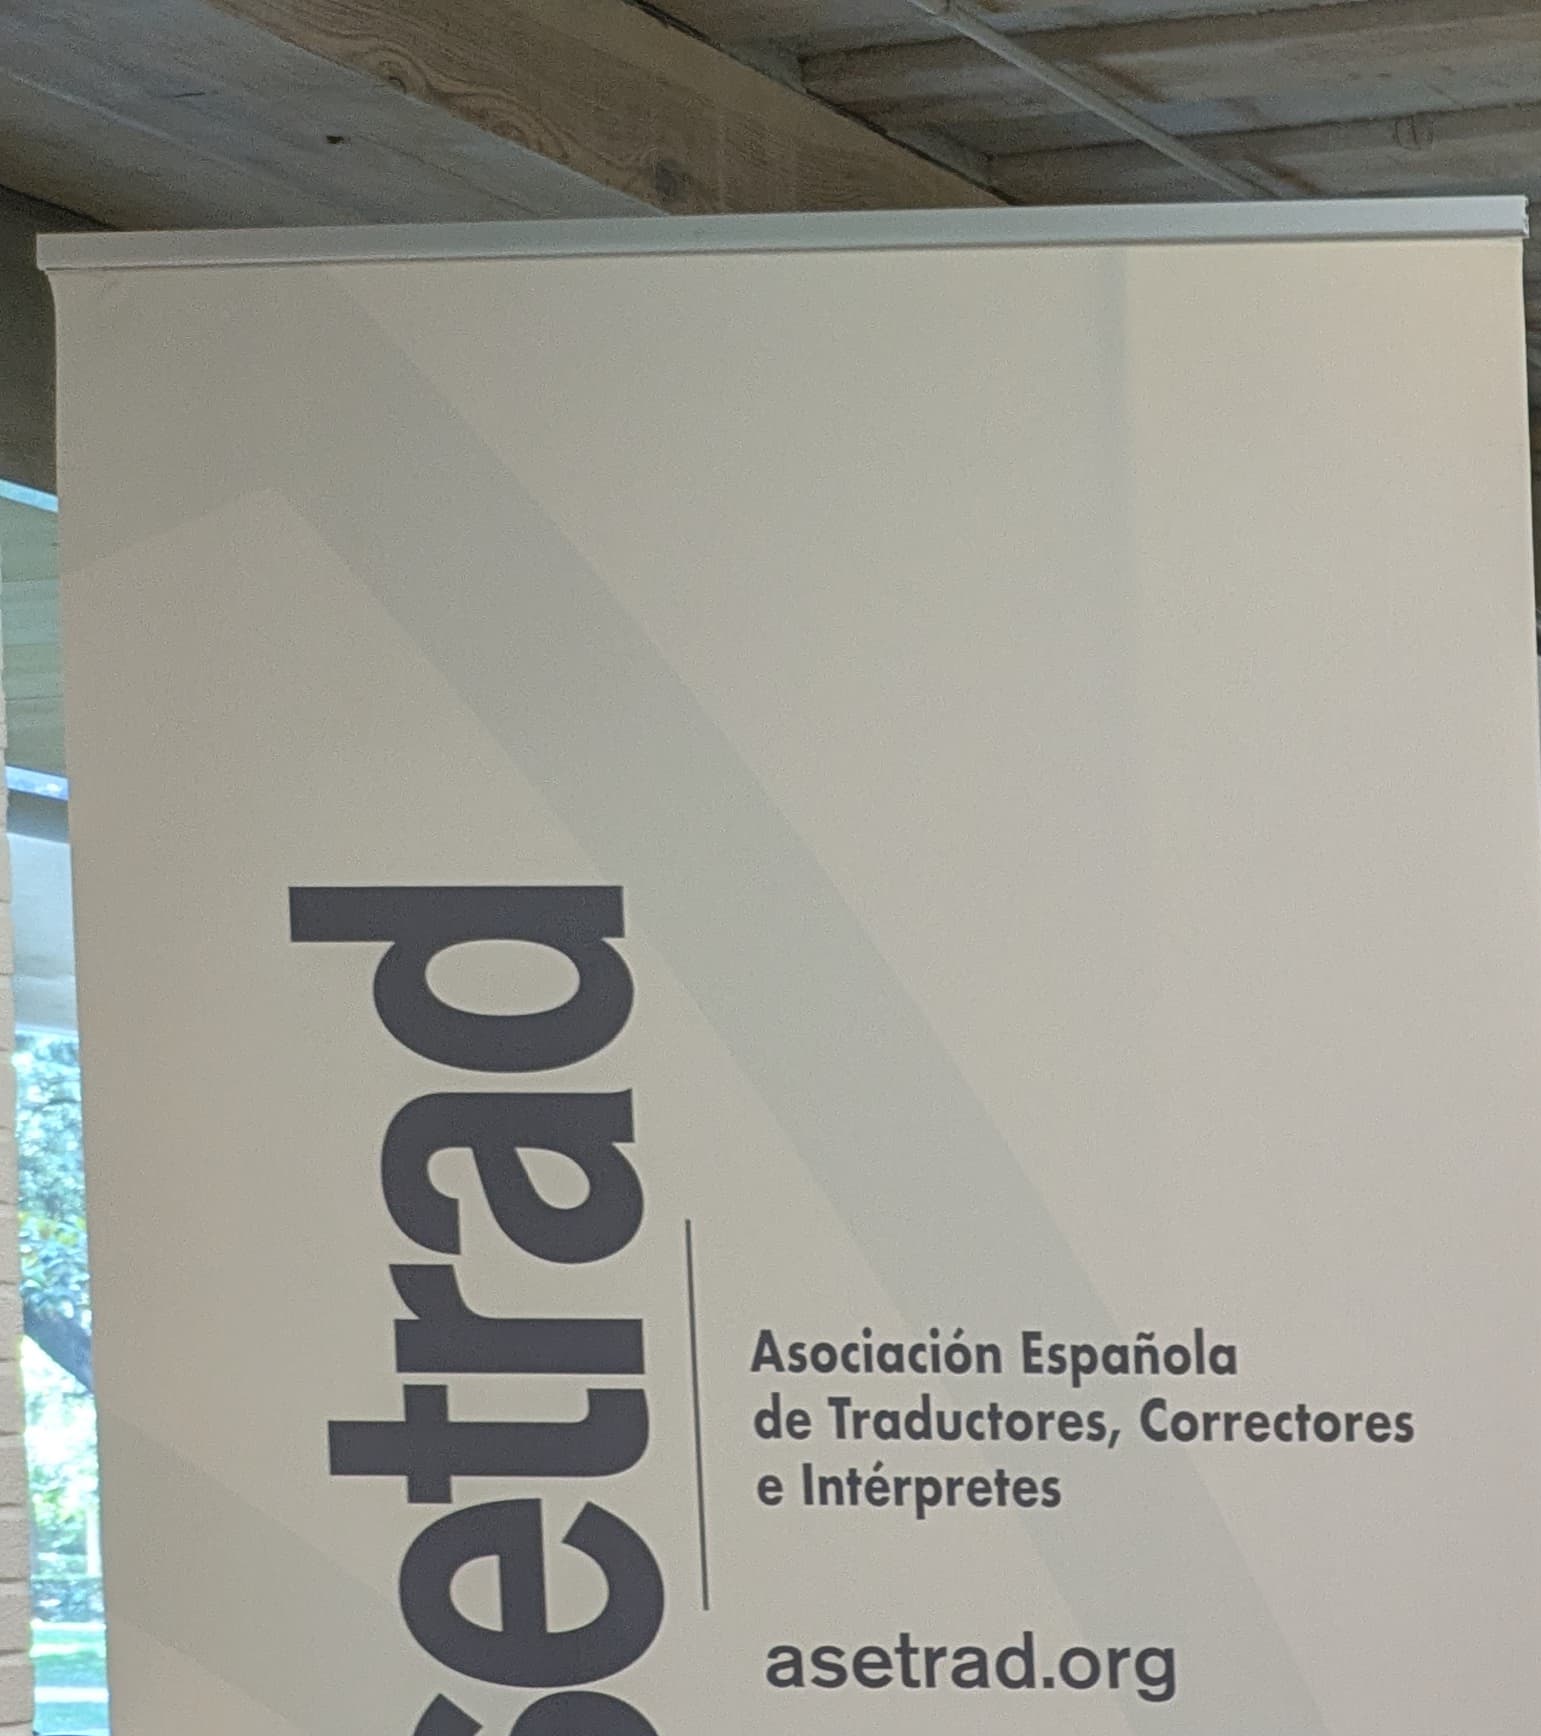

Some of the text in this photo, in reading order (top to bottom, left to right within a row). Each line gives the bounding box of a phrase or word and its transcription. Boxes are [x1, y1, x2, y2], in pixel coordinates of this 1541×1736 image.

[750, 1327, 1237, 1388] Asociación Española
[754, 1392, 1414, 1448] de Traductores, Correctores
[757, 1461, 1061, 1520] e Intérpretes
[766, 1631, 1176, 1703] asetrad.org
